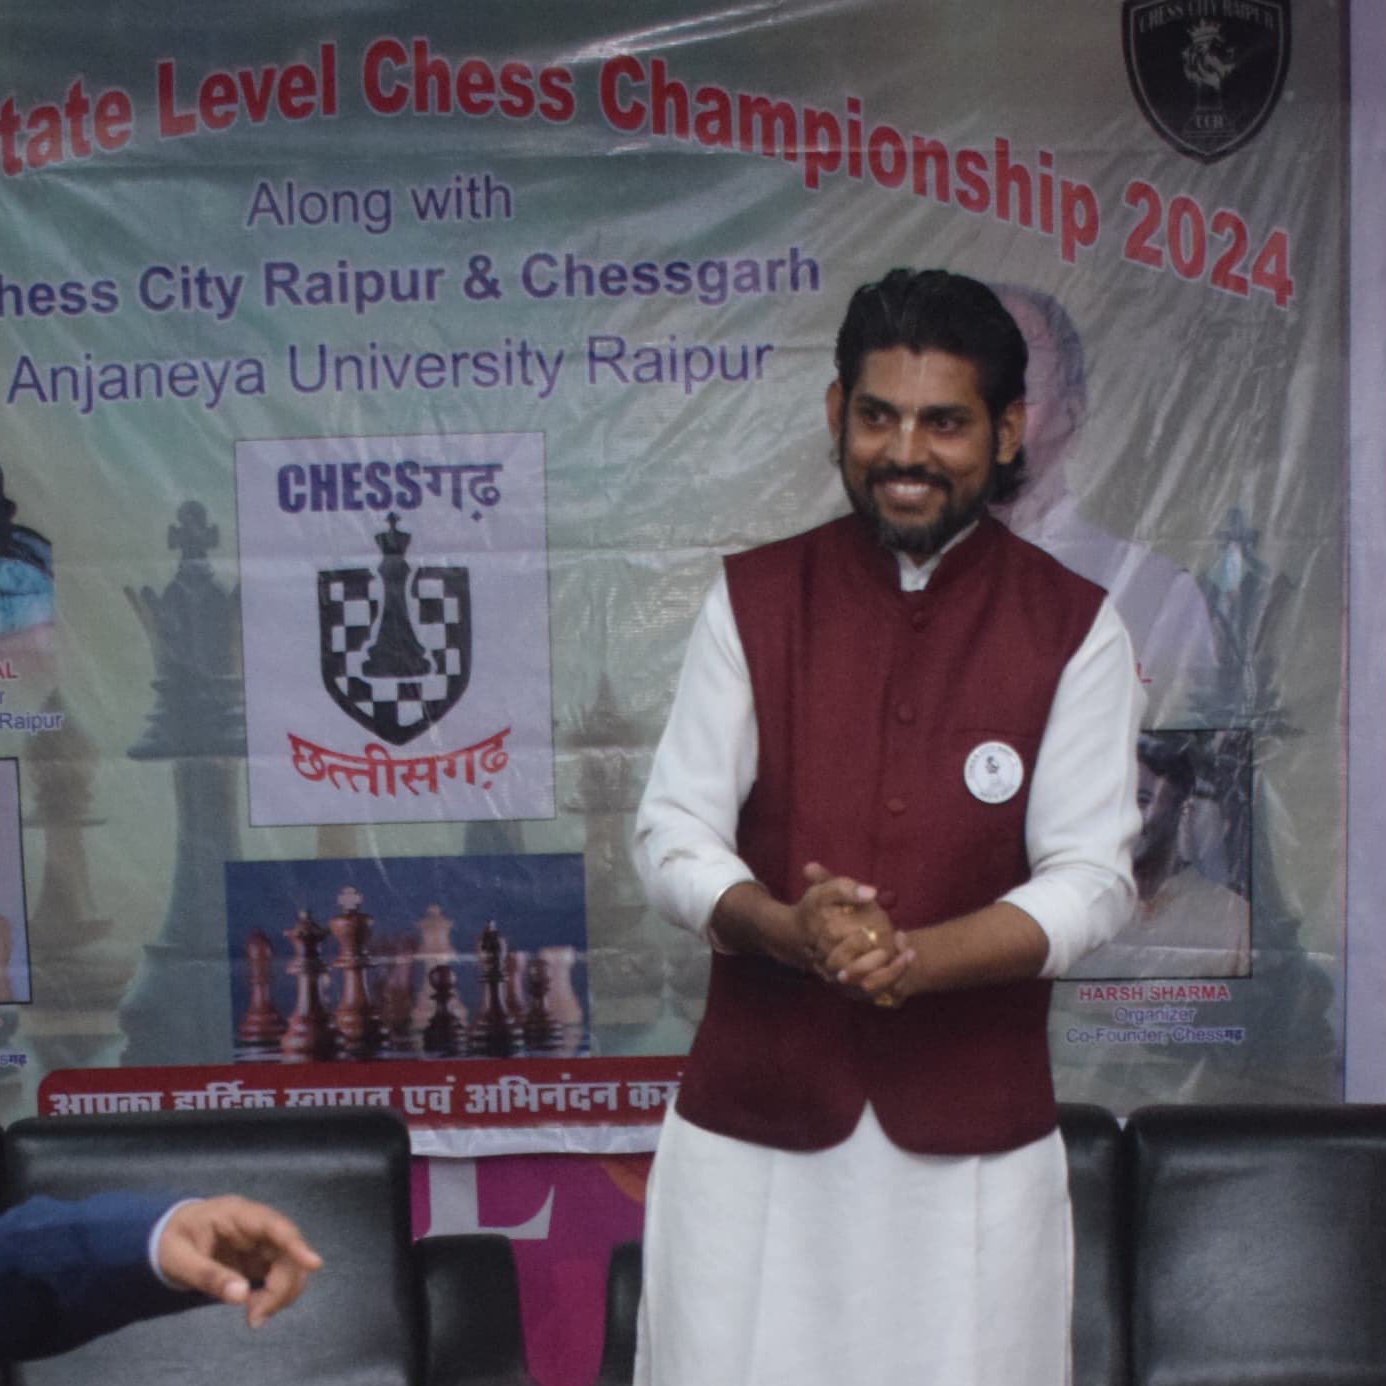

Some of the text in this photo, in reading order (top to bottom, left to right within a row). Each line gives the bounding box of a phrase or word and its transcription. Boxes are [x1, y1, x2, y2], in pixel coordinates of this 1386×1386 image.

[156, 43, 337, 138] Level
[363, 38, 575, 121] Chess
[600, 54, 1099, 263] Championship
[1123, 181, 1294, 309] 2024
[246, 175, 512, 234] Along with
[139, 264, 243, 320] City
[264, 260, 444, 315] Raipur
[463, 254, 501, 301] &
[522, 248, 819, 304] Chessgarh
[7, 335, 774, 413] Anjaneya University Raipur
[0, 711, 63, 732] Raipur
[1080, 984, 1231, 1001] HARSH SHARMA
[1115, 1007, 1197, 1023] Organizer
[401, 1074, 457, 1115] एवं
[465, 1073, 621, 1114] अभिनंदन
